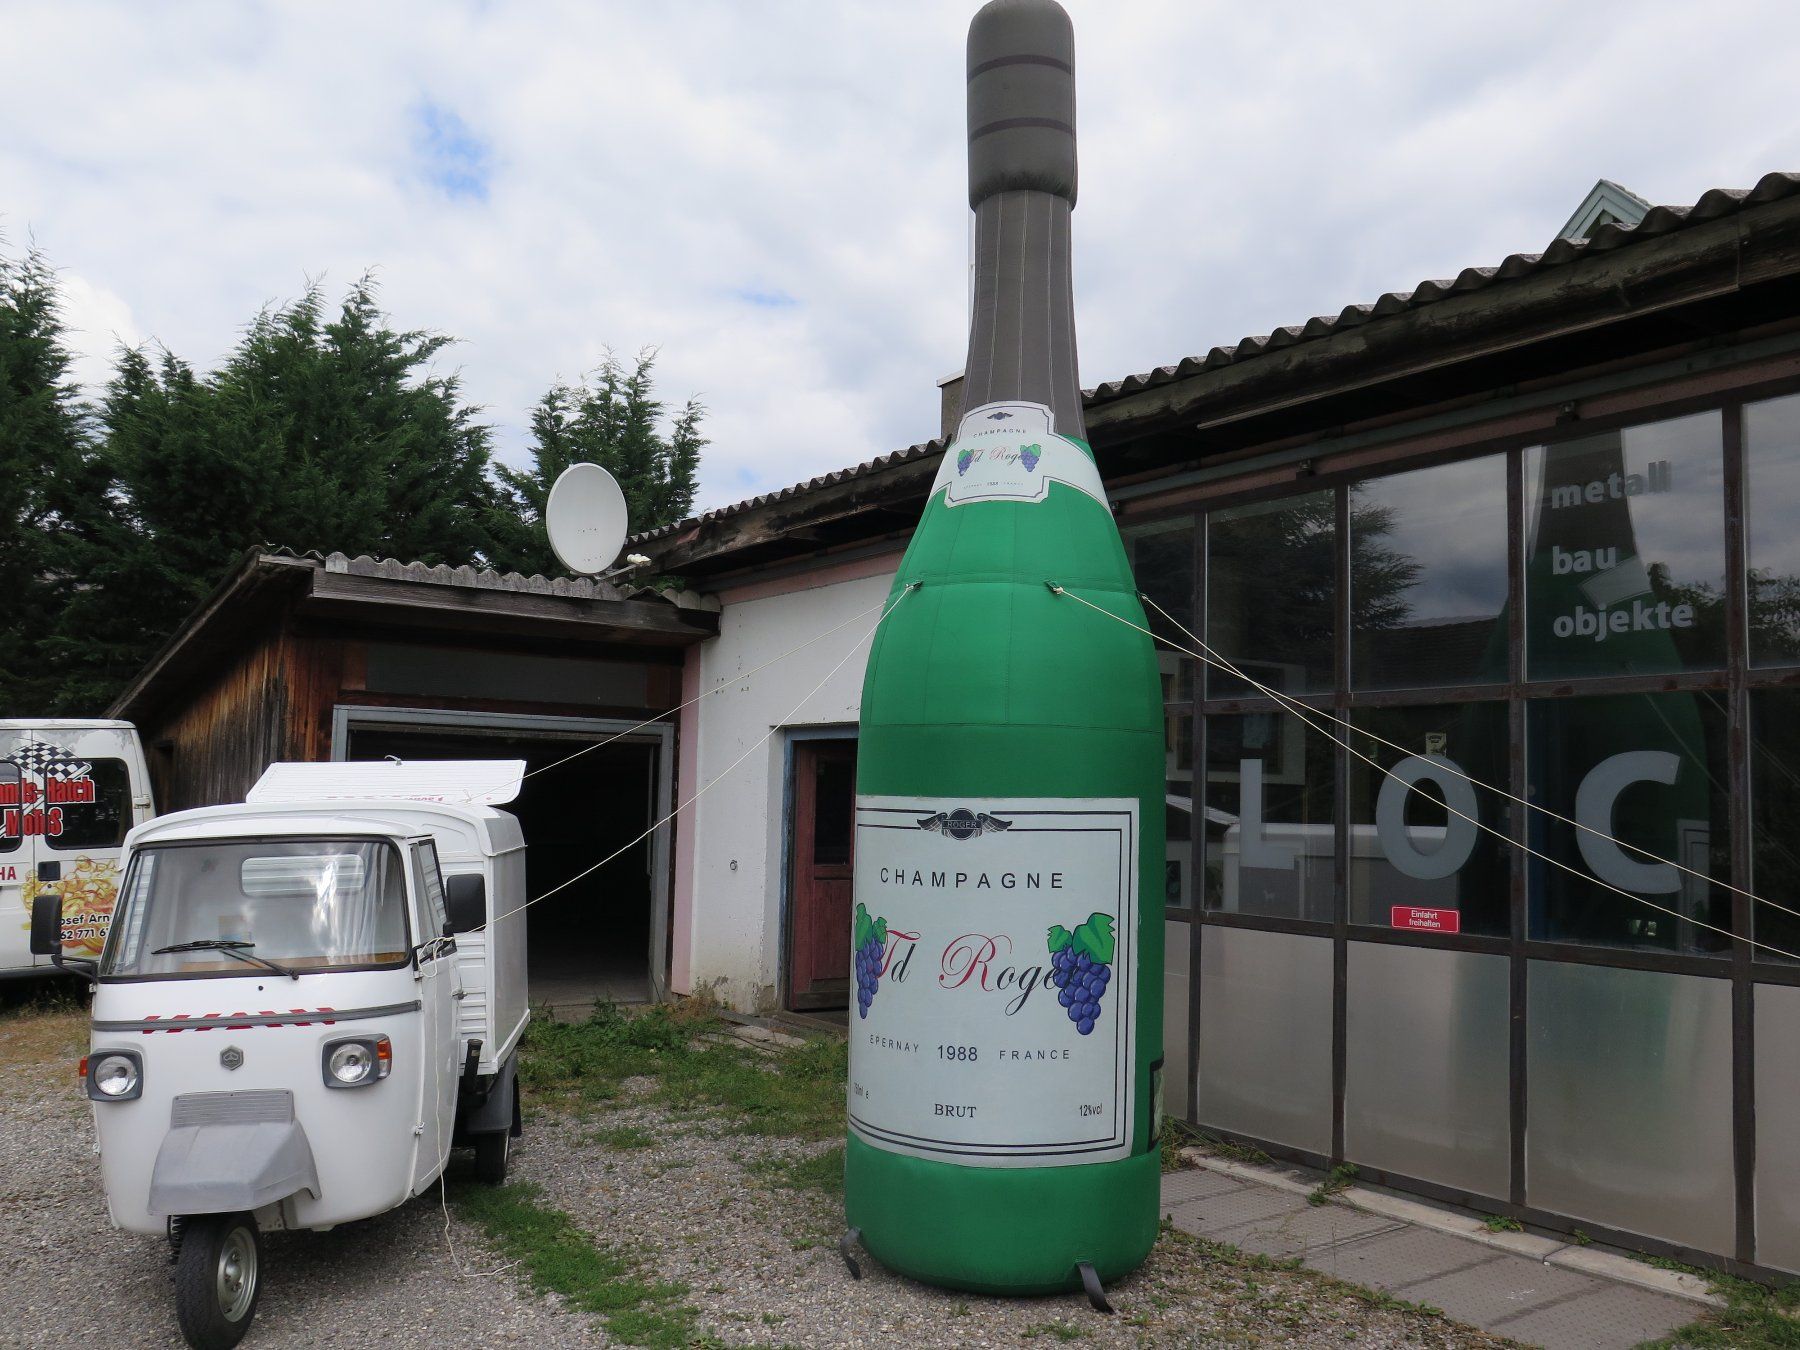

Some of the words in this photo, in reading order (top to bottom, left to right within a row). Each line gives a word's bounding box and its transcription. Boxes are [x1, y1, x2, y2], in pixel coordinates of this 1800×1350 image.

[973, 428, 1026, 439] CHAMPAGNE
[1551, 460, 1672, 509] metall
[1552, 546, 1617, 575] bau
[1553, 601, 1694, 642] objekte
[880, 867, 1063, 889] CHAMPAGNE
[60, 914, 84, 926] osef
[1411, 910, 1438, 919] Einfahrt
[1409, 919, 1441, 928] freihalten
[60, 930, 74, 940] 62
[76, 928, 95, 938] 771
[869, 1034, 919, 1053] EPERNAY
[937, 1045, 978, 1061] 1988
[999, 1050, 1070, 1060] FRANCE
[934, 1103, 977, 1118] BRUT
